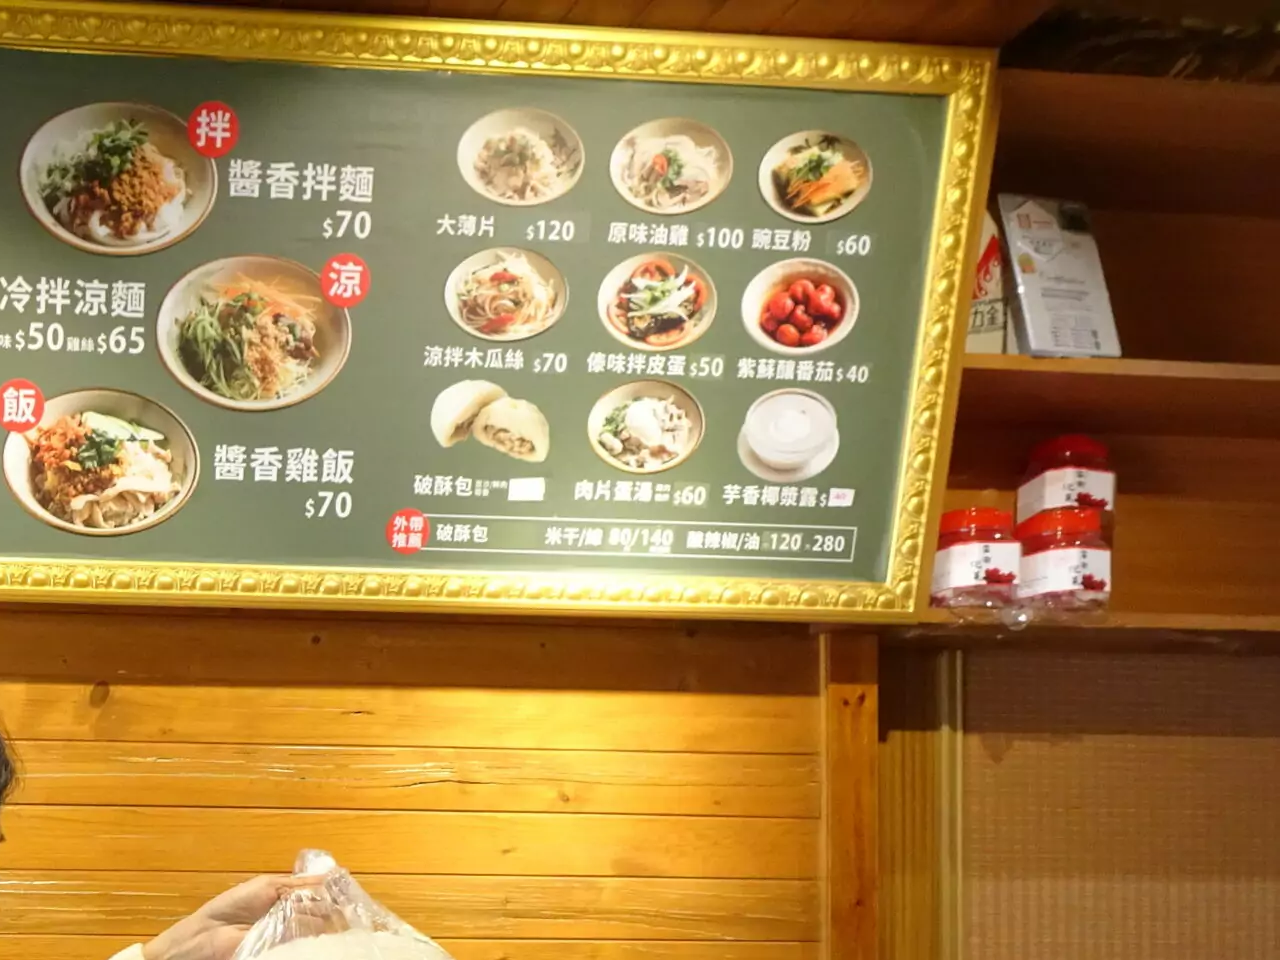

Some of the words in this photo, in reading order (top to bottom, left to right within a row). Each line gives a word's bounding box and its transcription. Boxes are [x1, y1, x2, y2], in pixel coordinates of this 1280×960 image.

[196, 109, 231, 148] 拌
[228, 159, 375, 203] 醬香拌麵
[322, 210, 372, 240] $70
[436, 214, 496, 238] 大薄片
[526, 220, 575, 242] $120
[607, 222, 689, 246] 原味油雞
[696, 227, 744, 250] $100
[751, 228, 812, 252] 豌豆粉
[836, 234, 871, 256] $60
[329, 261, 362, 299] 涼
[15, 322, 65, 352] $50
[97, 326, 145, 354] $65
[423, 345, 525, 370] 涼拌木瓜絲
[533, 353, 568, 374] $70
[586, 352, 686, 377] 傣味拌皮蛋
[689, 357, 724, 378] $50
[836, 365, 869, 384] $40
[2, 387, 37, 424] 飯
[214, 444, 355, 485] 醬香雞飯
[413, 475, 473, 497] 破酥包
[673, 486, 706, 506] $60
[305, 491, 352, 518] $70
[436, 524, 488, 543] 破酥包
[770, 532, 803, 551] 120
[812, 535, 845, 552] 280
